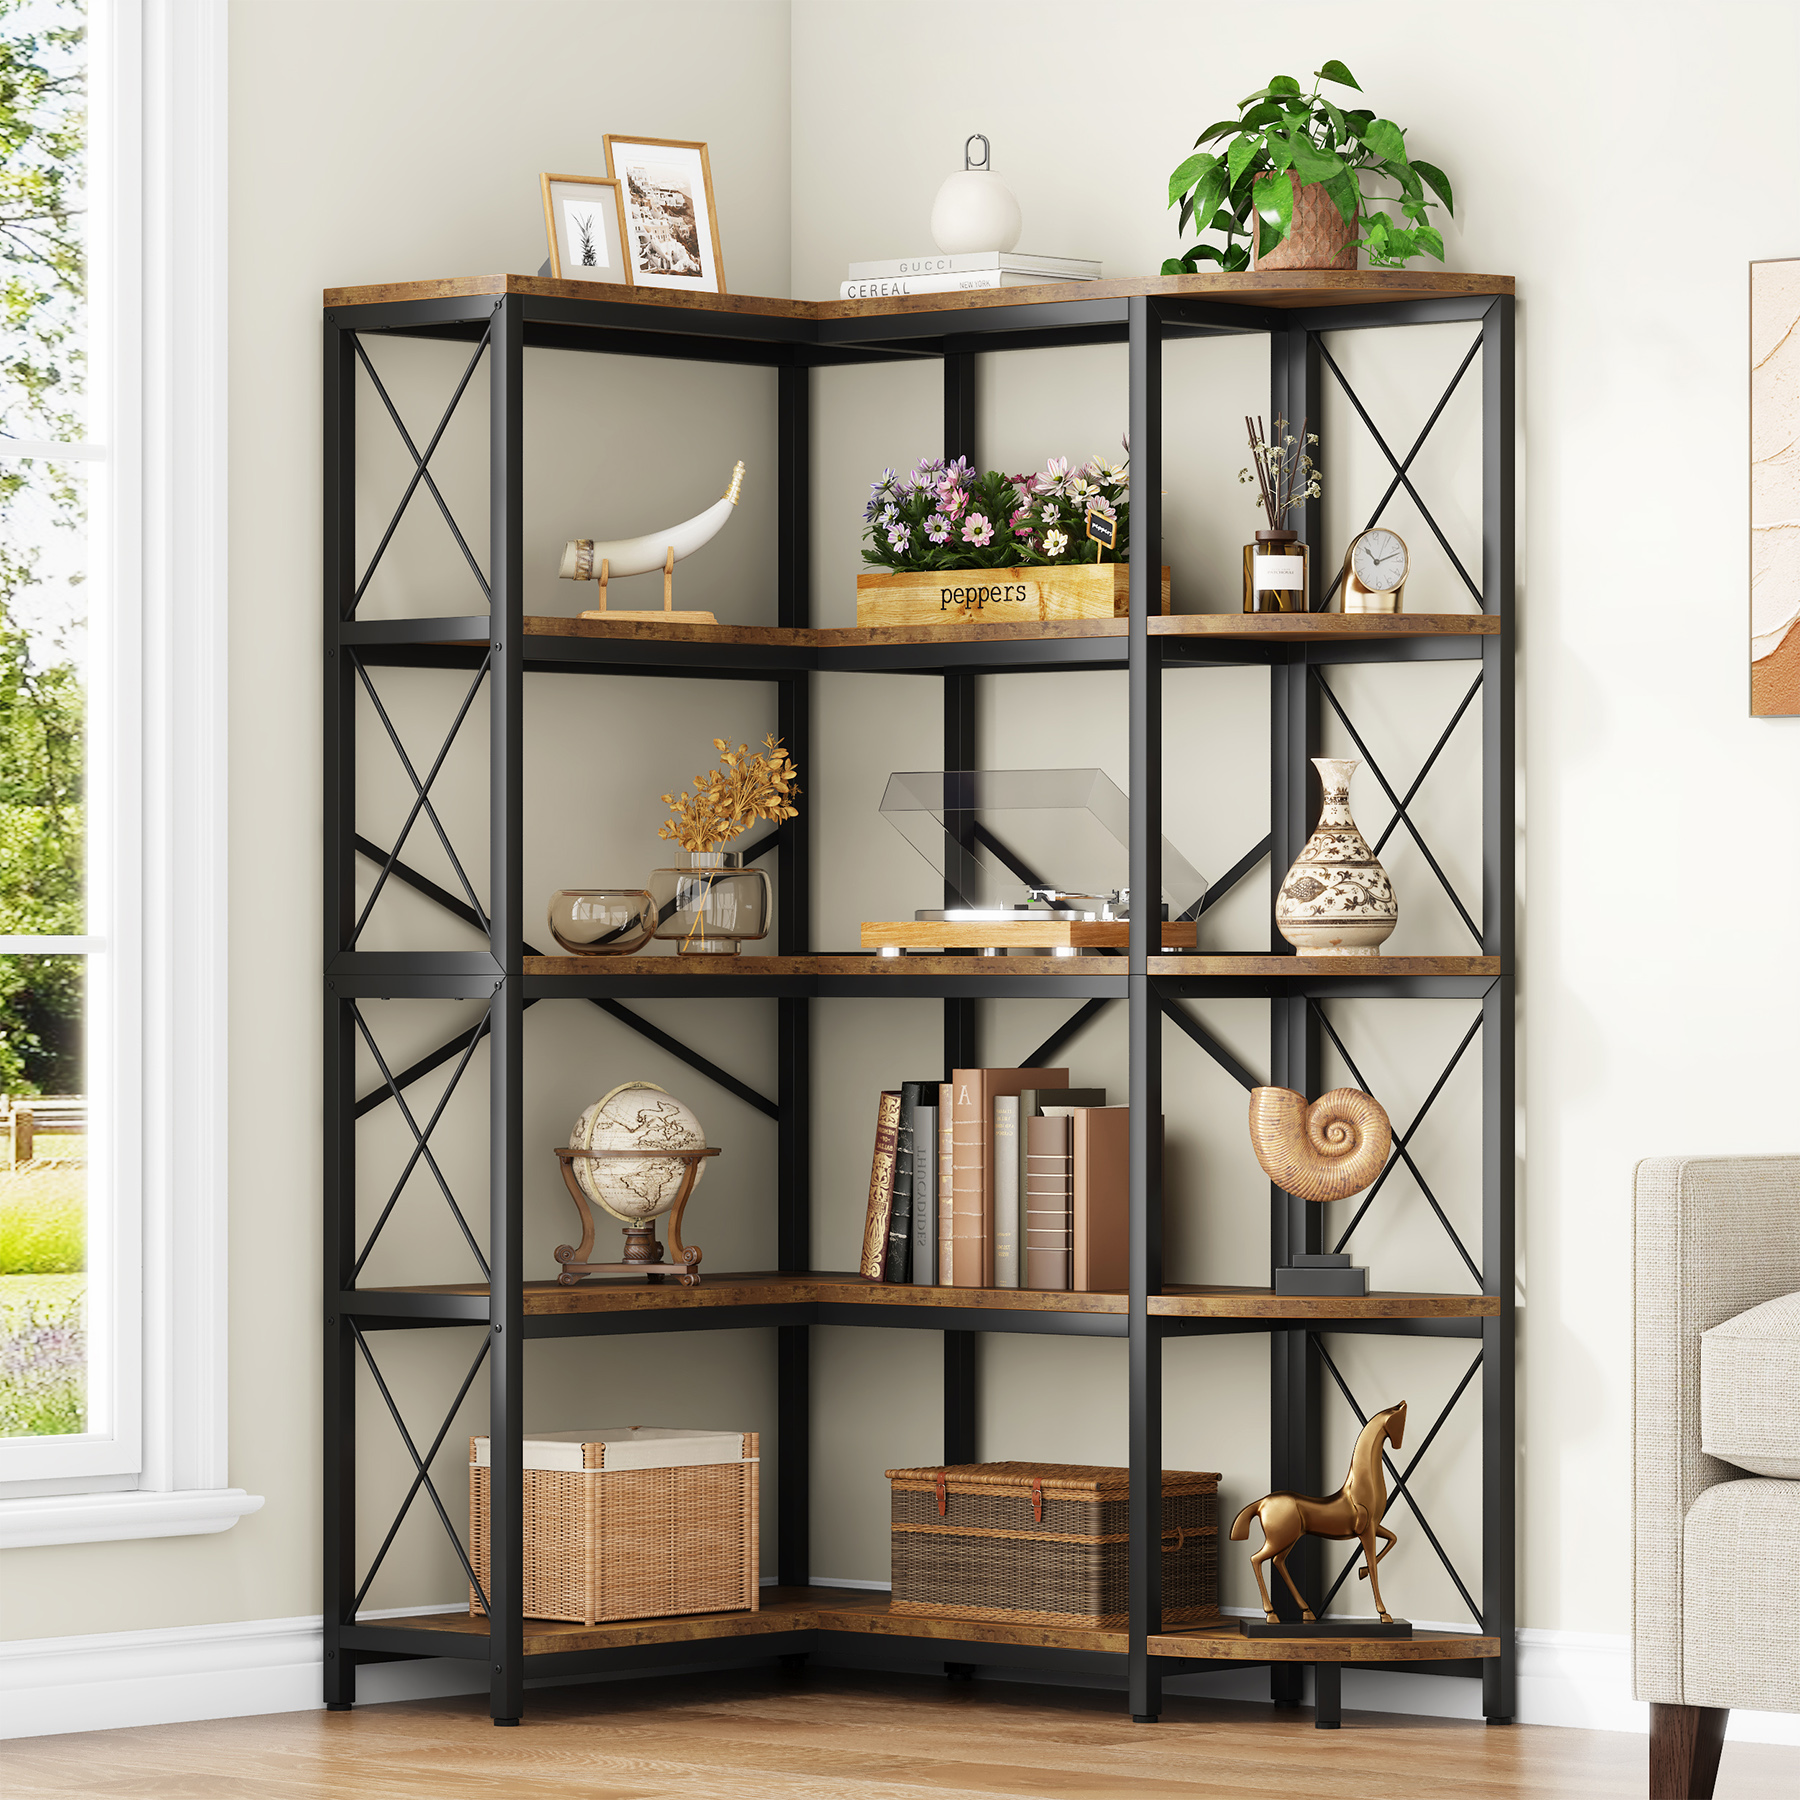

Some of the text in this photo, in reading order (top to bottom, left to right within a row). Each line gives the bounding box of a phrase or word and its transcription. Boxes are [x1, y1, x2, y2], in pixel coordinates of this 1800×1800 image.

[899, 260, 952, 272] GUCCI
[847, 282, 910, 298] CEREAL
[959, 279, 991, 289] NEW YORK
[940, 585, 1027, 611] peppers
[957, 1084, 972, 1105] A
